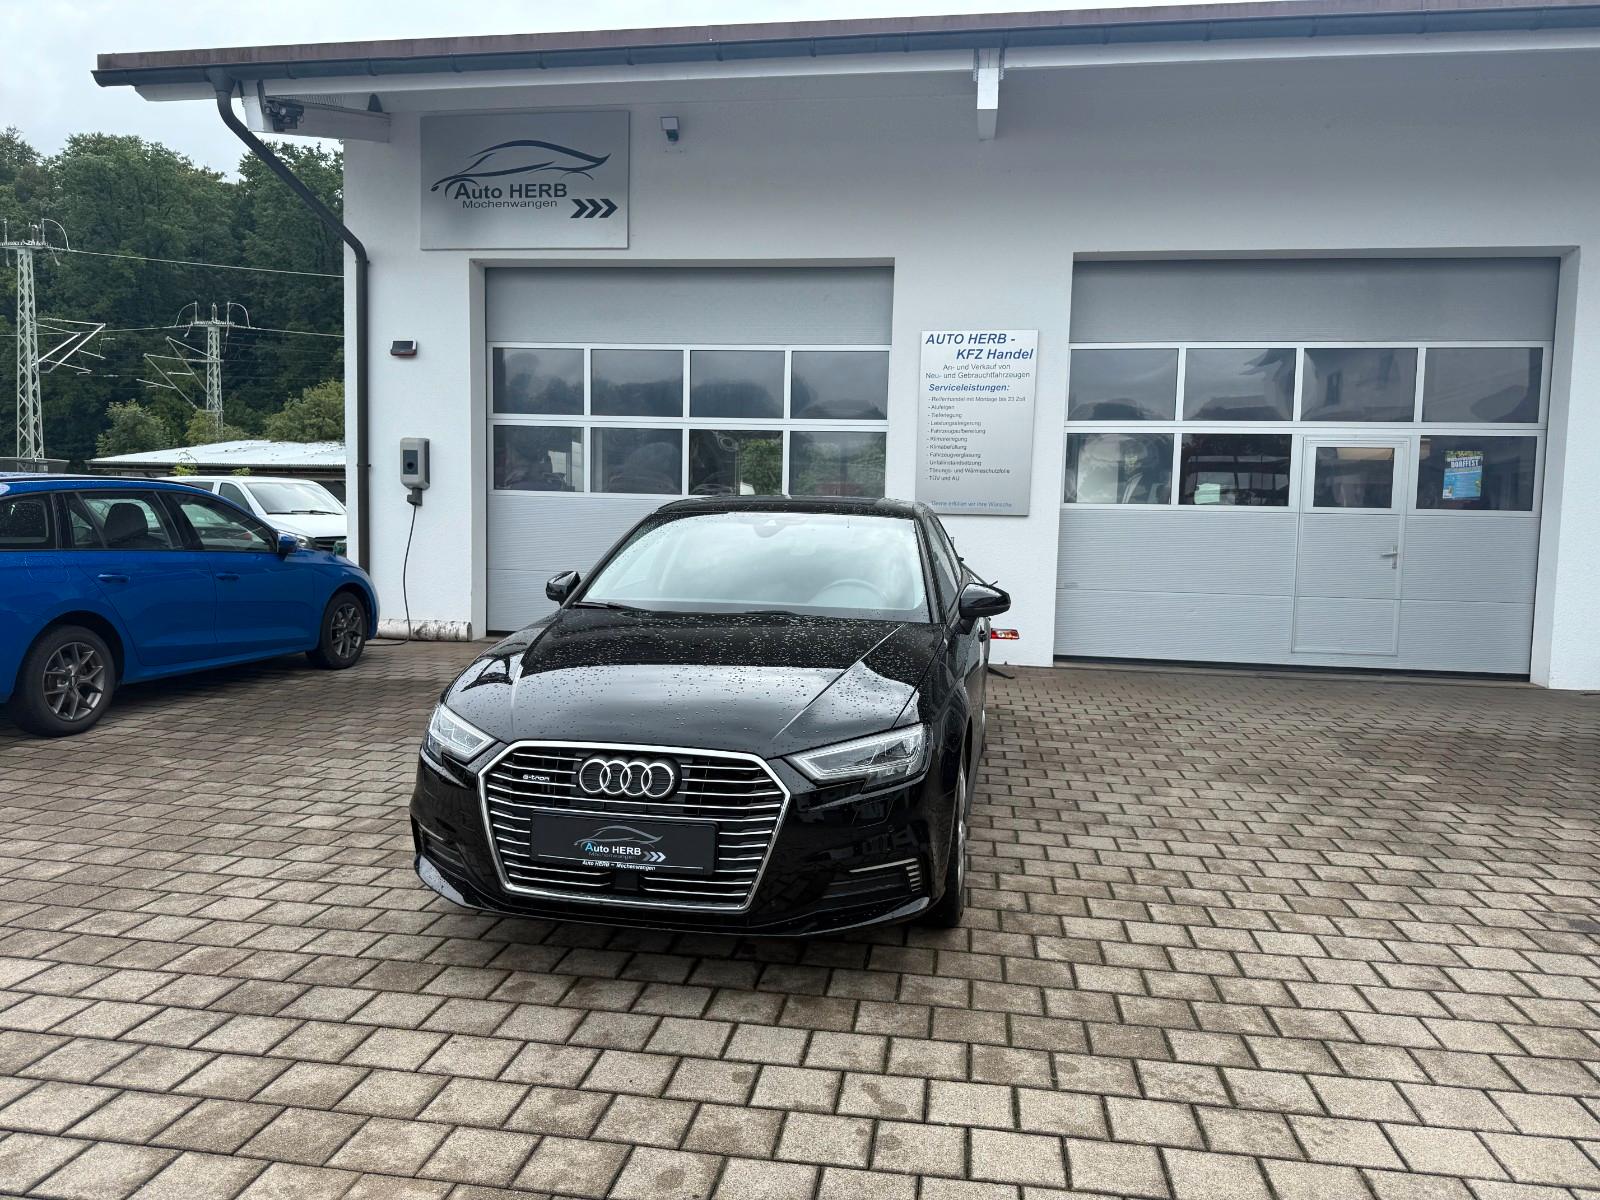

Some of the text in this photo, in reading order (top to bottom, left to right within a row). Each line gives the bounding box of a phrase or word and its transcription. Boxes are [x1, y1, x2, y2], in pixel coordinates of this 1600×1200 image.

[454, 183, 568, 200] Auto HERB
[462, 200, 558, 210] Mochenwangen
[925, 333, 965, 345] AUTO
[967, 333, 1008, 344] HERB
[956, 348, 1034, 360] KFZ Handel
[957, 371, 1031, 379] Gebrauchtfahrzeugen
[928, 383, 1010, 392] Serviceleistungen:
[584, 842, 642, 856] Auto HERB
